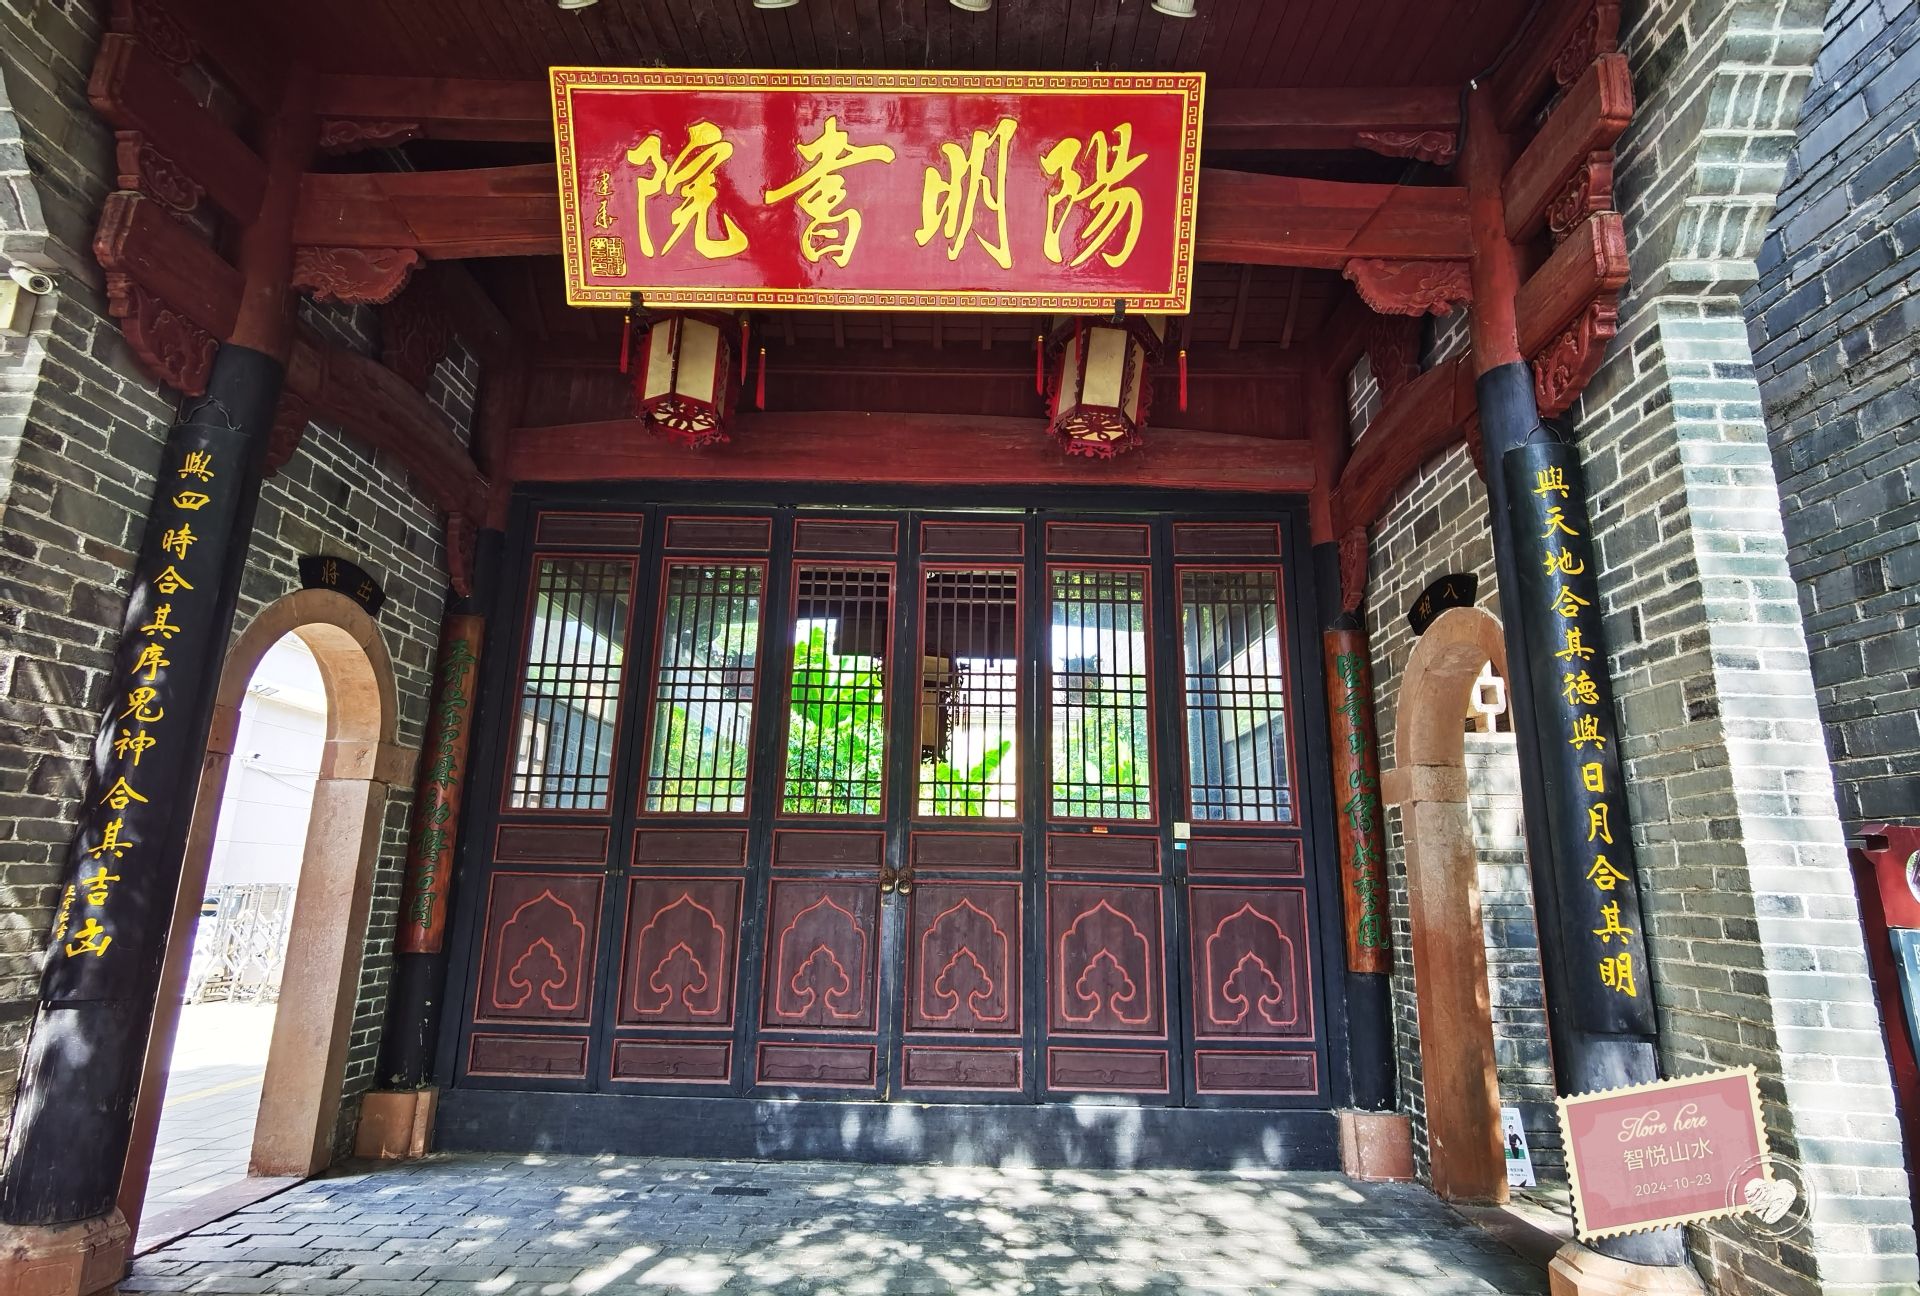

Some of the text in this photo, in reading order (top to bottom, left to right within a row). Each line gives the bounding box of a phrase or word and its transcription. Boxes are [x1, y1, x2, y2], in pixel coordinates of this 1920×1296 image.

[627, 116, 1149, 270] 陽明書院
[1532, 465, 1637, 998] 與天地合其德與日月合其明
